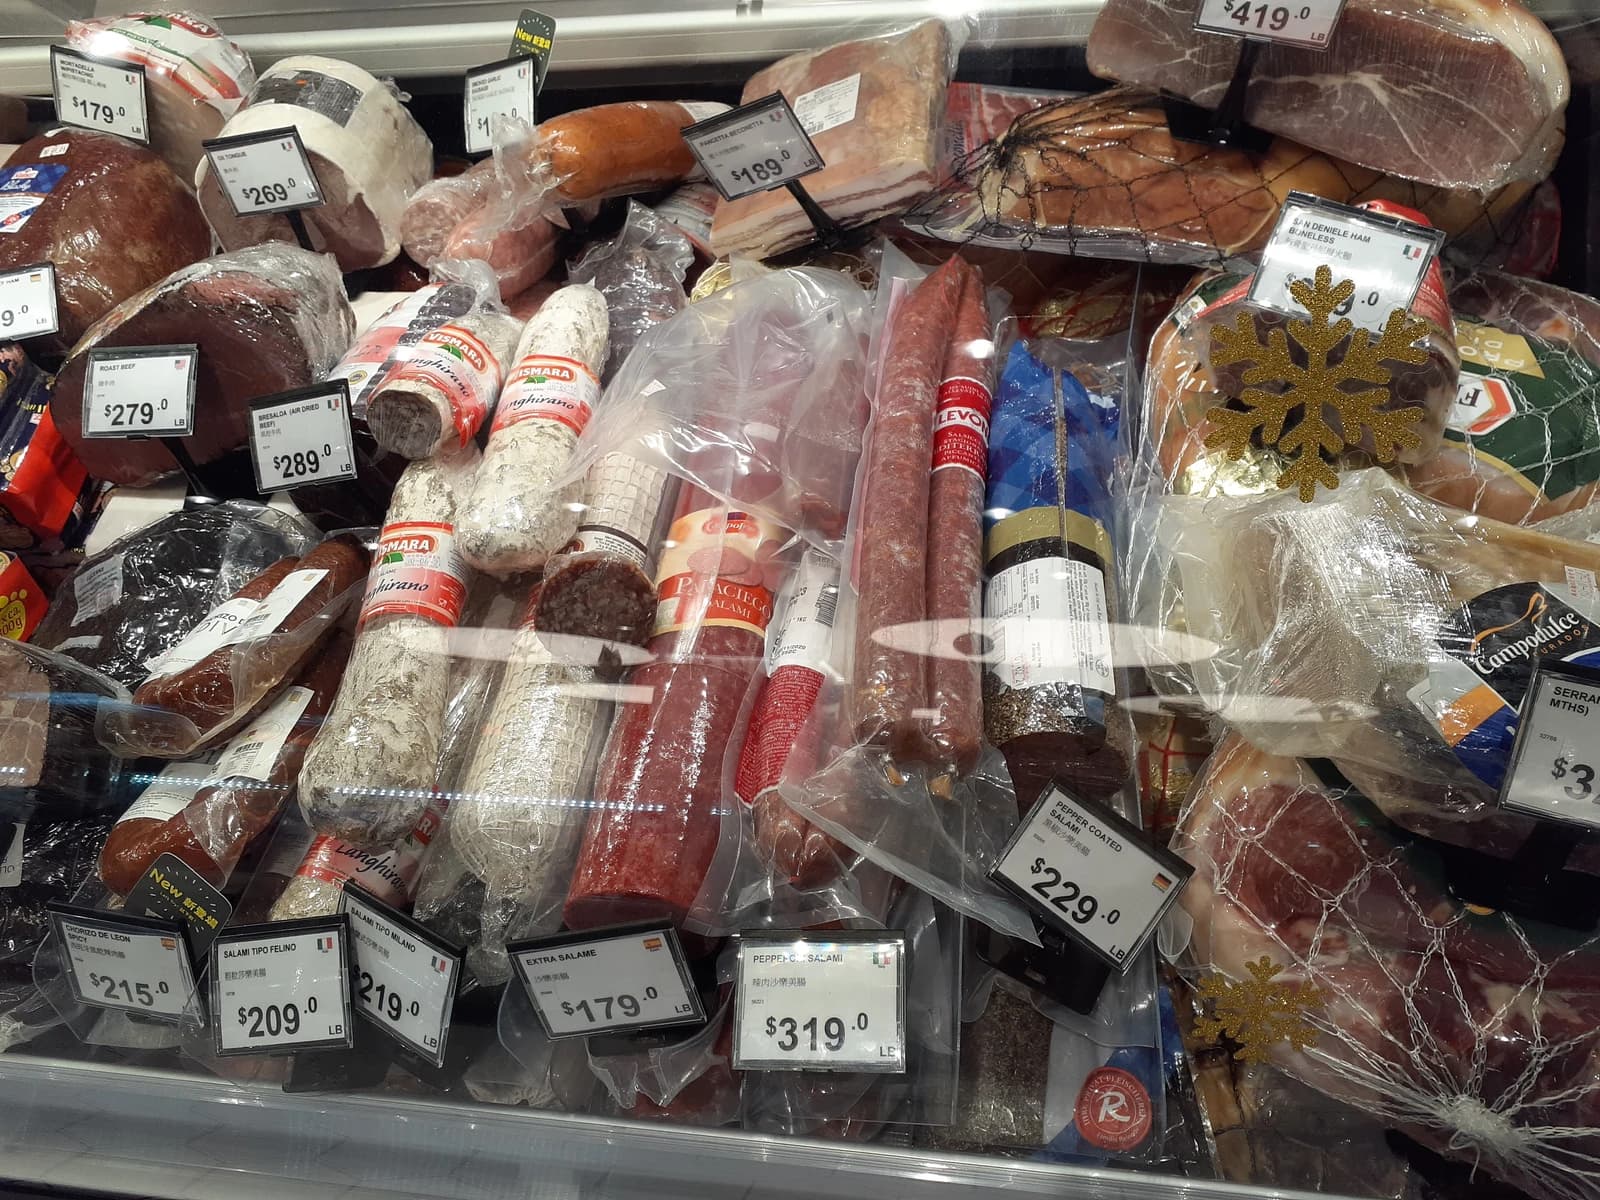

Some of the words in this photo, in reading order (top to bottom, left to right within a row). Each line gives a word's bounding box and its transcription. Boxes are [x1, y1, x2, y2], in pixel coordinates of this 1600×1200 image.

[1224, 0, 1311, 31] $419.0
[515, 27, 532, 42] New
[1311, 32, 1325, 41] LB
[72, 96, 121, 124] $179.0
[131, 126, 142, 134] LB
[731, 150, 791, 184] $189.0
[804, 159, 816, 169] LB
[242, 177, 296, 206] $269.0
[1349, 233, 1372, 245] HAM
[428, 332, 483, 370] VISMARA
[99, 364, 120, 373] ROAST
[120, 362, 137, 371] BEEF
[519, 367, 570, 380] ISMARA
[104, 398, 168, 427] $279.0
[301, 402, 320, 416] DRIED
[174, 418, 186, 427] LB
[259, 420, 277, 430] BEEF)
[938, 409, 989, 441] LEVON
[273, 443, 332, 479] $289.0
[340, 463, 352, 473] LB
[1474, 613, 1580, 674] Campodulce
[1549, 698, 1590, 718] MTHS)
[1049, 808, 1083, 836] SALAMI
[1055, 800, 1090, 829] PEPPER
[1087, 824, 1123, 853] COATED
[149, 868, 183, 899] New
[1030, 856, 1122, 926] $229.0
[65, 923, 97, 938] CHORIZO
[97, 930, 110, 940] DE
[110, 932, 131, 943] LEON
[67, 932, 87, 944] SPICY
[350, 906, 374, 929] SALAMI
[374, 922, 392, 937] TIPO
[390, 932, 417, 953] MILANO
[223, 948, 251, 959] SALAMI
[251, 947, 269, 956] TIPO
[269, 943, 297, 954] FELINO
[525, 954, 558, 967] EXTRA
[557, 949, 598, 962] SALAME
[807, 953, 844, 963] SALAMI
[1109, 944, 1126, 961] LB
[88, 972, 169, 1007] $215.0
[560, 986, 659, 1023] $179.0
[674, 1003, 691, 1015] LB
[237, 996, 318, 1038] $209.0
[328, 1024, 343, 1036] LB
[765, 1012, 870, 1052] $319.0
[423, 1035, 438, 1049] LB
